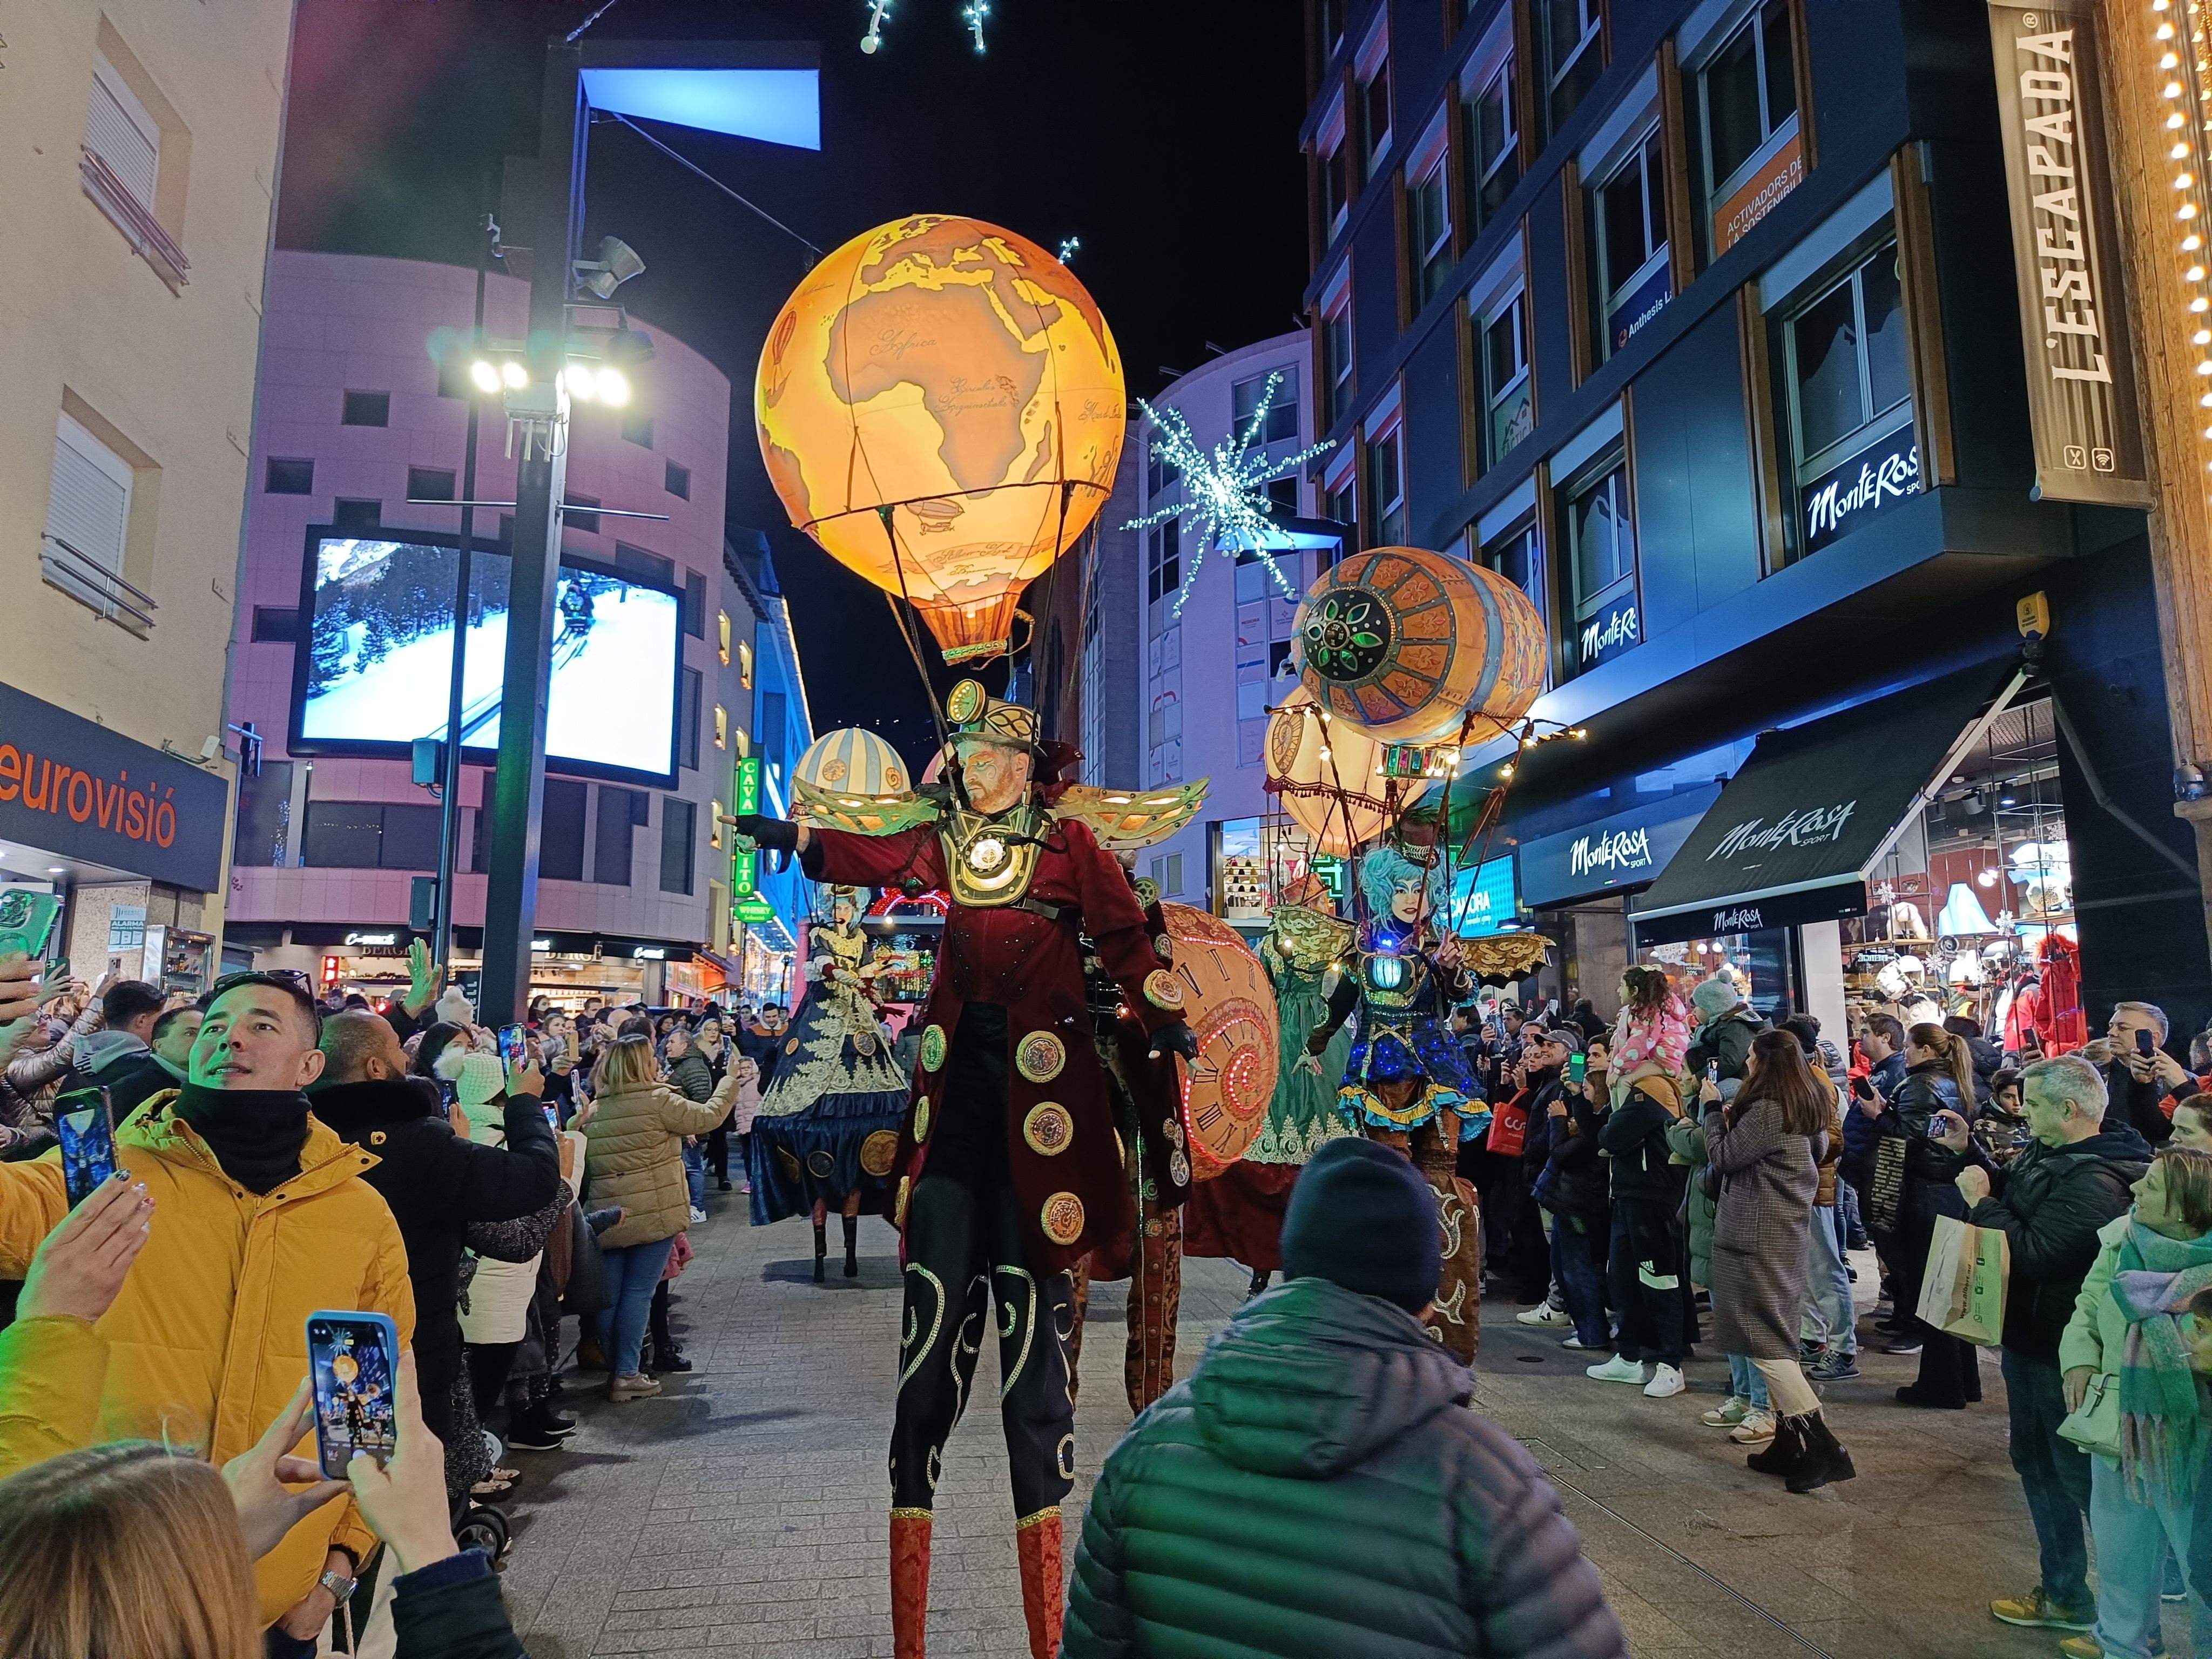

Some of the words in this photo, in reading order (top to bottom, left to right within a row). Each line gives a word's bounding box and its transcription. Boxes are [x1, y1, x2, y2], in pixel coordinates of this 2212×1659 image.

[1728, 170, 1787, 236] ACTIVADORS
[1629, 299, 1663, 339] Anthesis
[0, 744, 176, 848] eurovisió
[741, 761, 755, 810] CAVA
[1800, 833, 1831, 846] SPORT
[1630, 858, 1646, 869] SPORT
